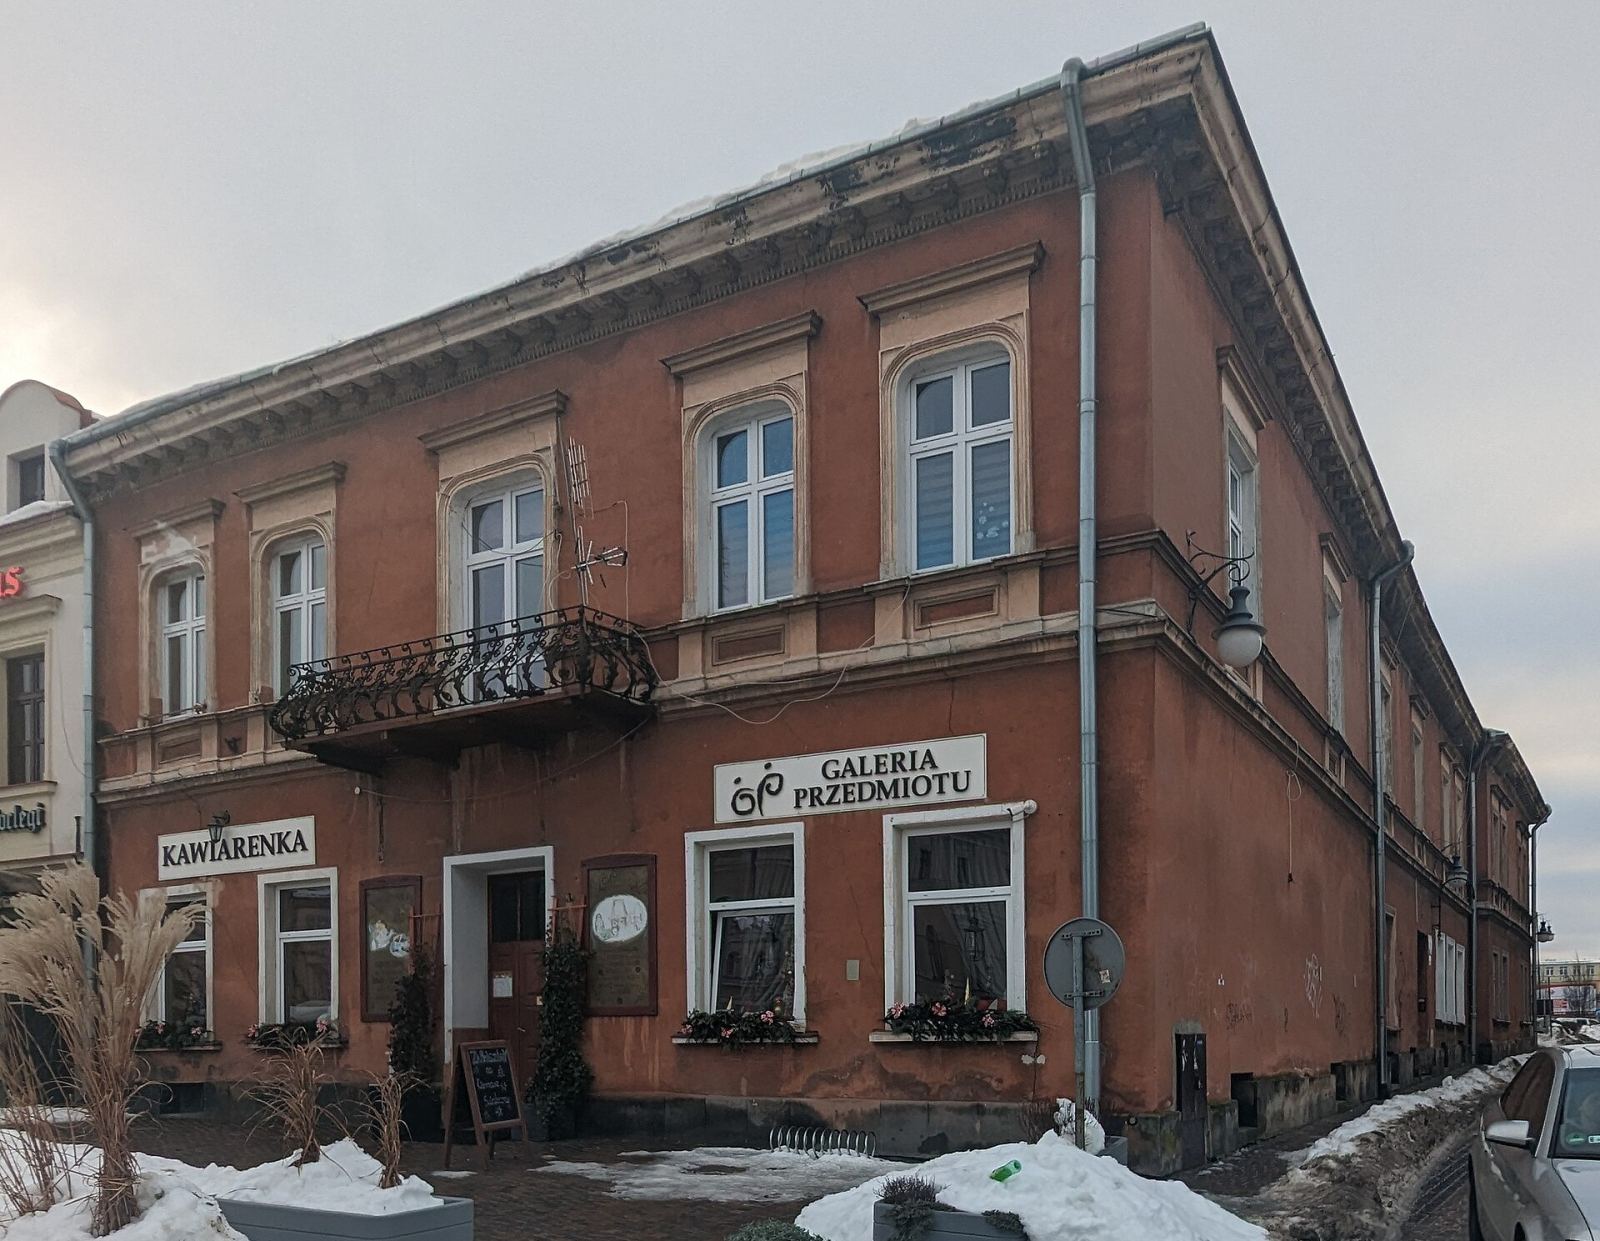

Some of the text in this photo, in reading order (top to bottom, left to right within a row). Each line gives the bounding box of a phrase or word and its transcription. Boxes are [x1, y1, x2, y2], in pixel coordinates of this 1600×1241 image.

[821, 749, 938, 780] GALERIA
[793, 770, 971, 809] PRZEDMIOTU
[162, 829, 309, 866] KAWIARENKA
